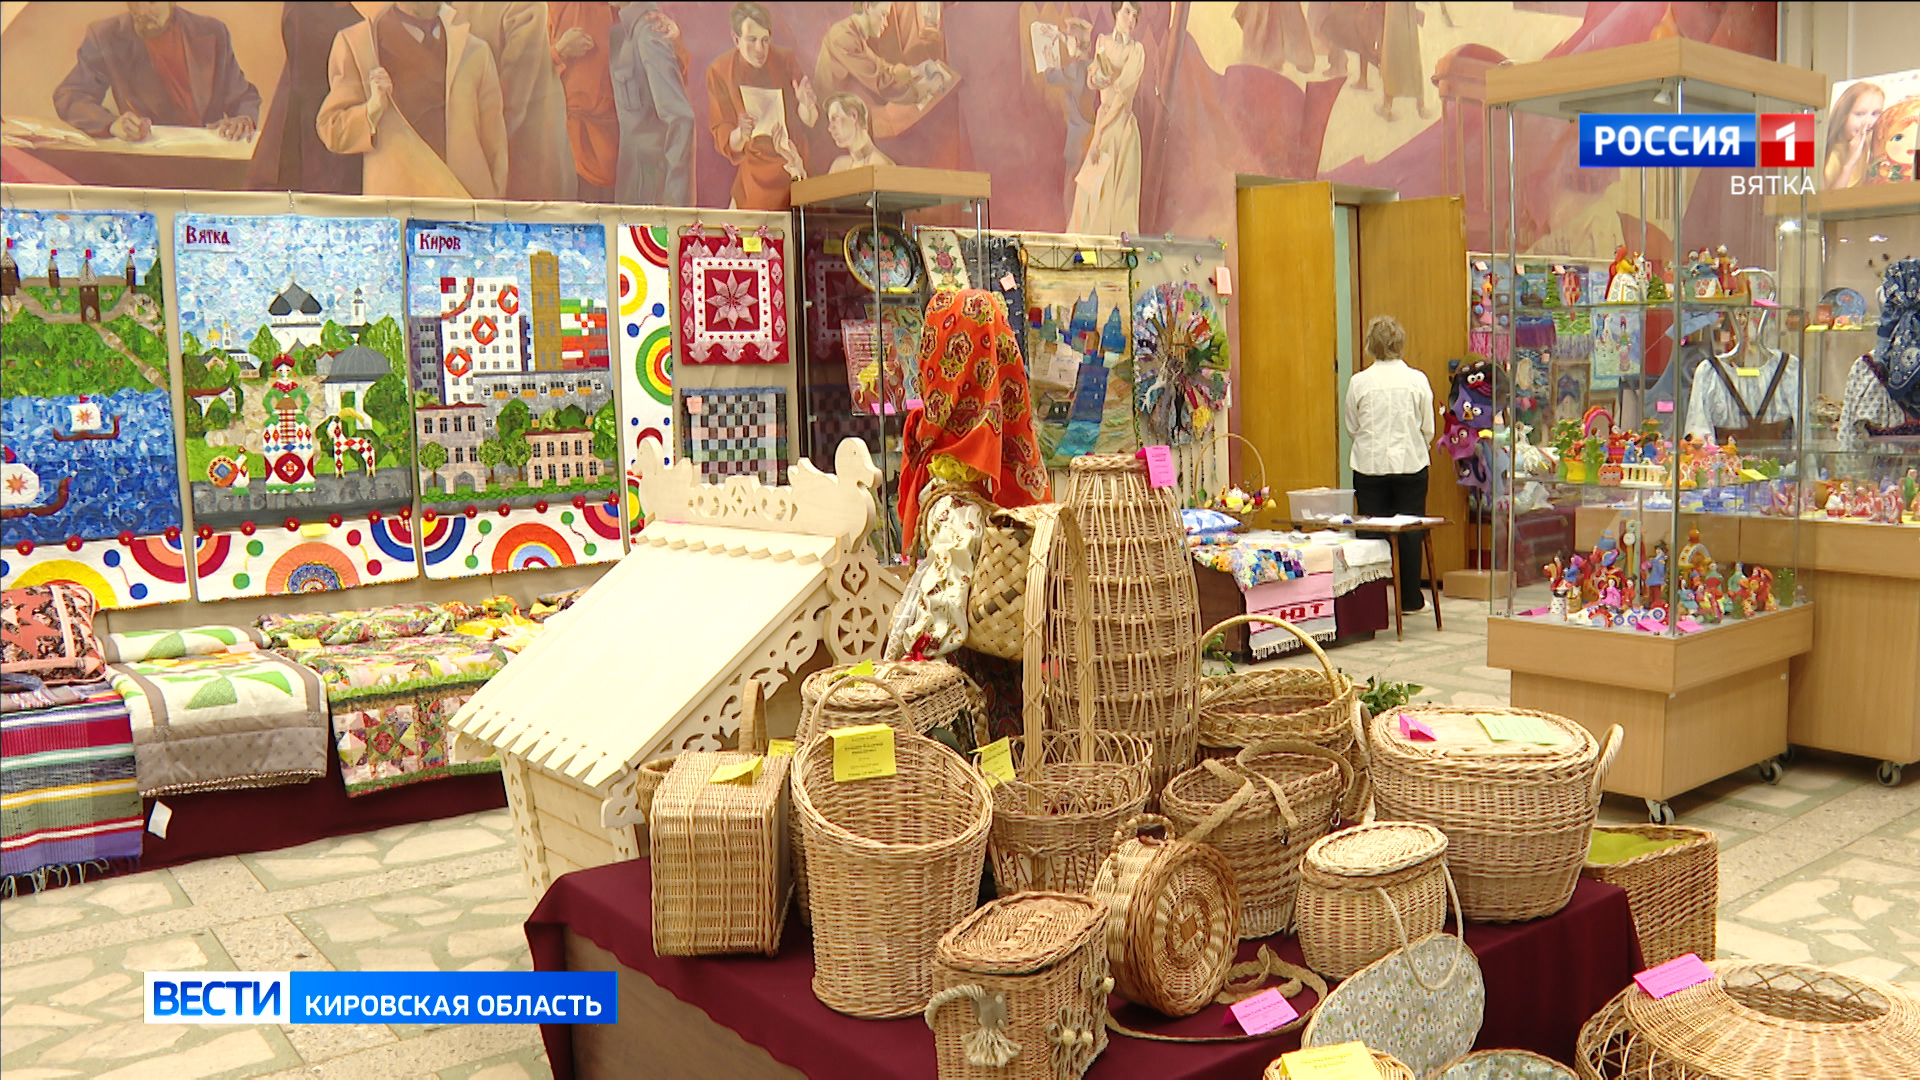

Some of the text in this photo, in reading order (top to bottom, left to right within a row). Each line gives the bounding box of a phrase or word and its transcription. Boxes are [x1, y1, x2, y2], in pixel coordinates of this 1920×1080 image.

[185, 224, 231, 245] Вятка
[419, 231, 462, 254] Киров
[1260, 603, 1325, 627] ЮТ
